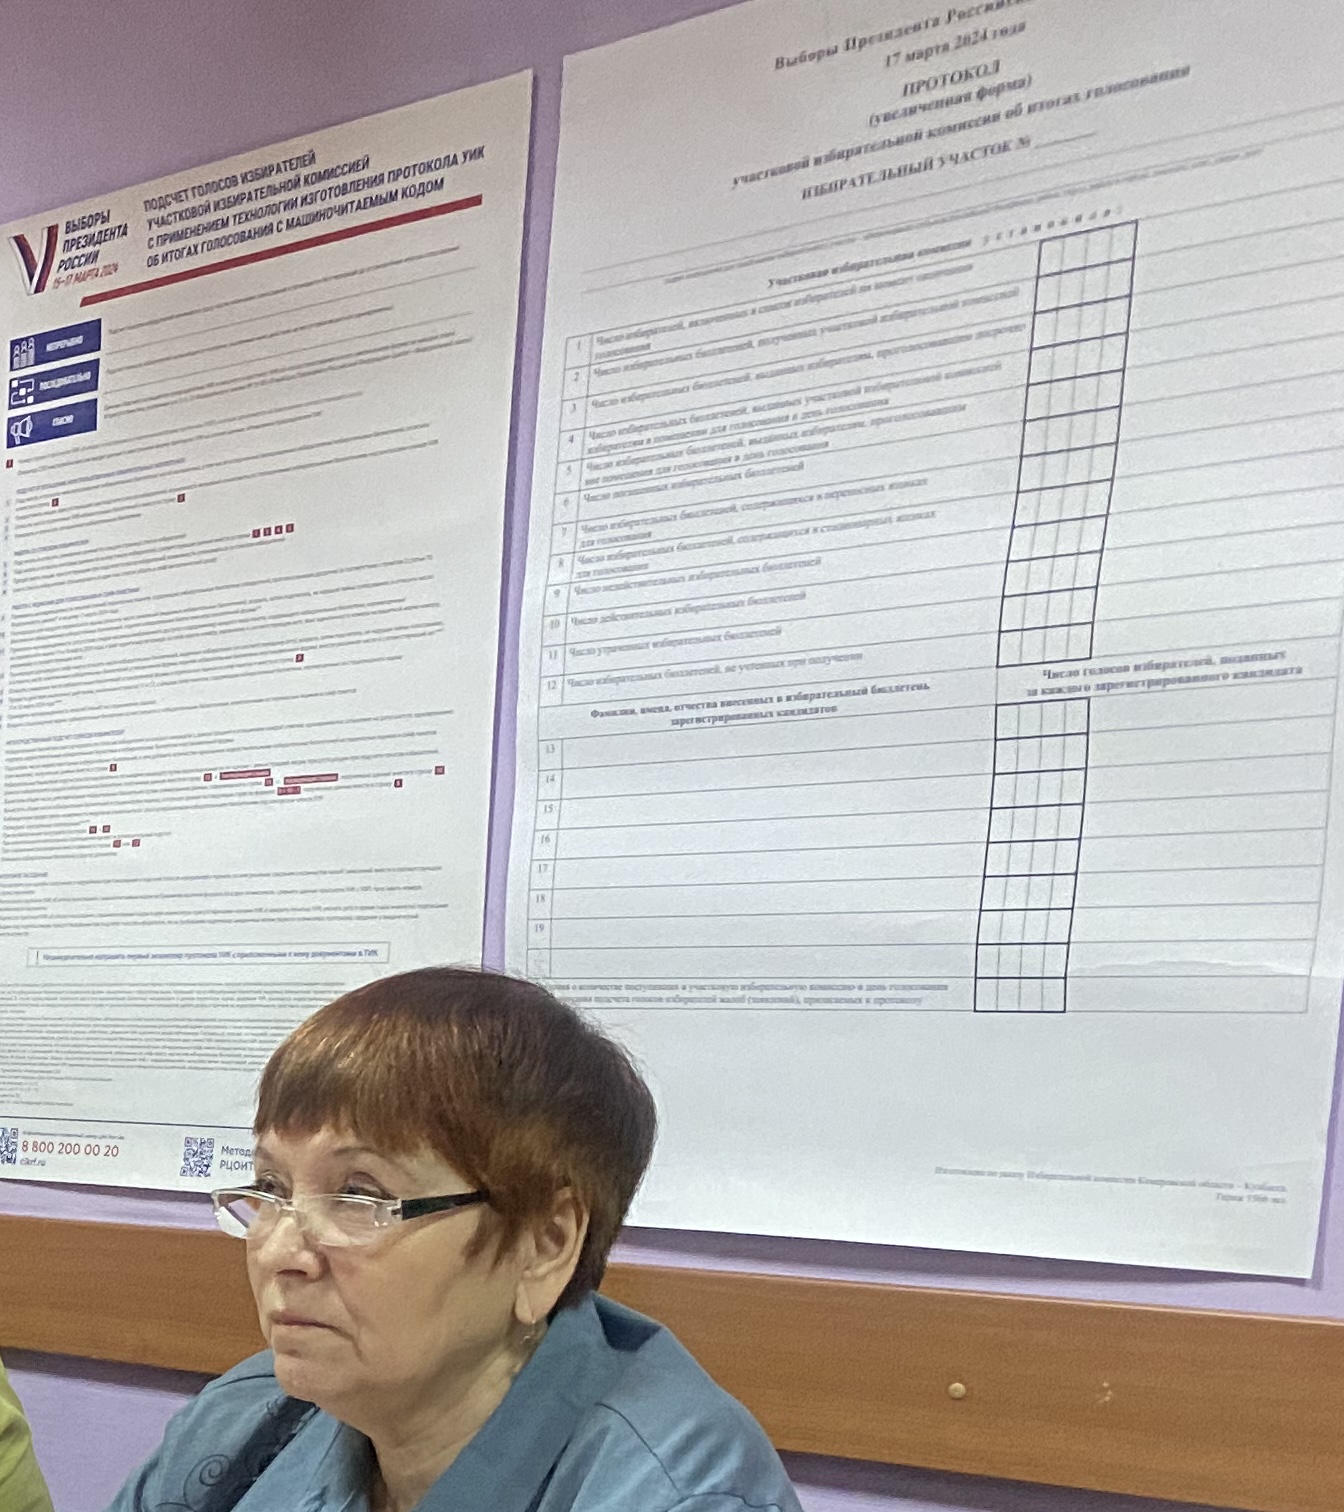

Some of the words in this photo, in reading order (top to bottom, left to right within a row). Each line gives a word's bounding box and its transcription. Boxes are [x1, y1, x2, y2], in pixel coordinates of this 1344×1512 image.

[773, 40, 838, 73] Выборы
[884, 50, 902, 69] 17
[903, 38, 950, 66] марта
[901, 58, 1000, 98] ПРОТОКОЛ
[144, 190, 189, 212] ПОДСЧЕТ
[192, 175, 239, 199] ГОЛОСОВ
[240, 148, 316, 185] ИЗБИРАТЕЛЕЙ
[147, 200, 211, 231] УЧАСТКОВОЙ
[213, 173, 301, 212] ИЗБИРАТЕЛЬНОЙ
[303, 154, 370, 187] КОМИССИЕЙ
[148, 238, 154, 249] С
[156, 216, 229, 247] ПРИМЕНЕНИЕМ
[232, 197, 298, 226] ТЕХНОЛОГИИ
[300, 173, 384, 207] ИЗГОТОВЛЕНИЯ
[387, 153, 459, 183] ПРОТОКОЛА
[462, 145, 485, 164] УИК
[65, 209, 110, 234] ВЫБОРЫ
[147, 253, 160, 268] ОБ
[161, 243, 199, 265] ИТОГАХ
[201, 222, 274, 253] ГОЛОСОВАНИЯ
[276, 220, 283, 233] С
[286, 188, 398, 231] МАШИНОЧИТАЕМЫМ
[401, 177, 444, 201] КОДОМ
[63, 223, 128, 253] ПРЕЗИДЕНТА
[57, 250, 100, 273] РОССИИ
[545, 743, 555, 753] 13
[545, 774, 555, 783] 14
[543, 804, 553, 813] 15
[540, 834, 550, 844] 16
[537, 863, 548, 873] 17
[535, 893, 546, 903] 18
[534, 923, 545, 932] 19
[22, 1140, 29, 1152] 8
[32, 1141, 54, 1154] 800
[58, 1142, 81, 1155] 200
[84, 1144, 100, 1156] 00
[103, 1145, 119, 1157] 20
[221, 1145, 253, 1158] Метод
